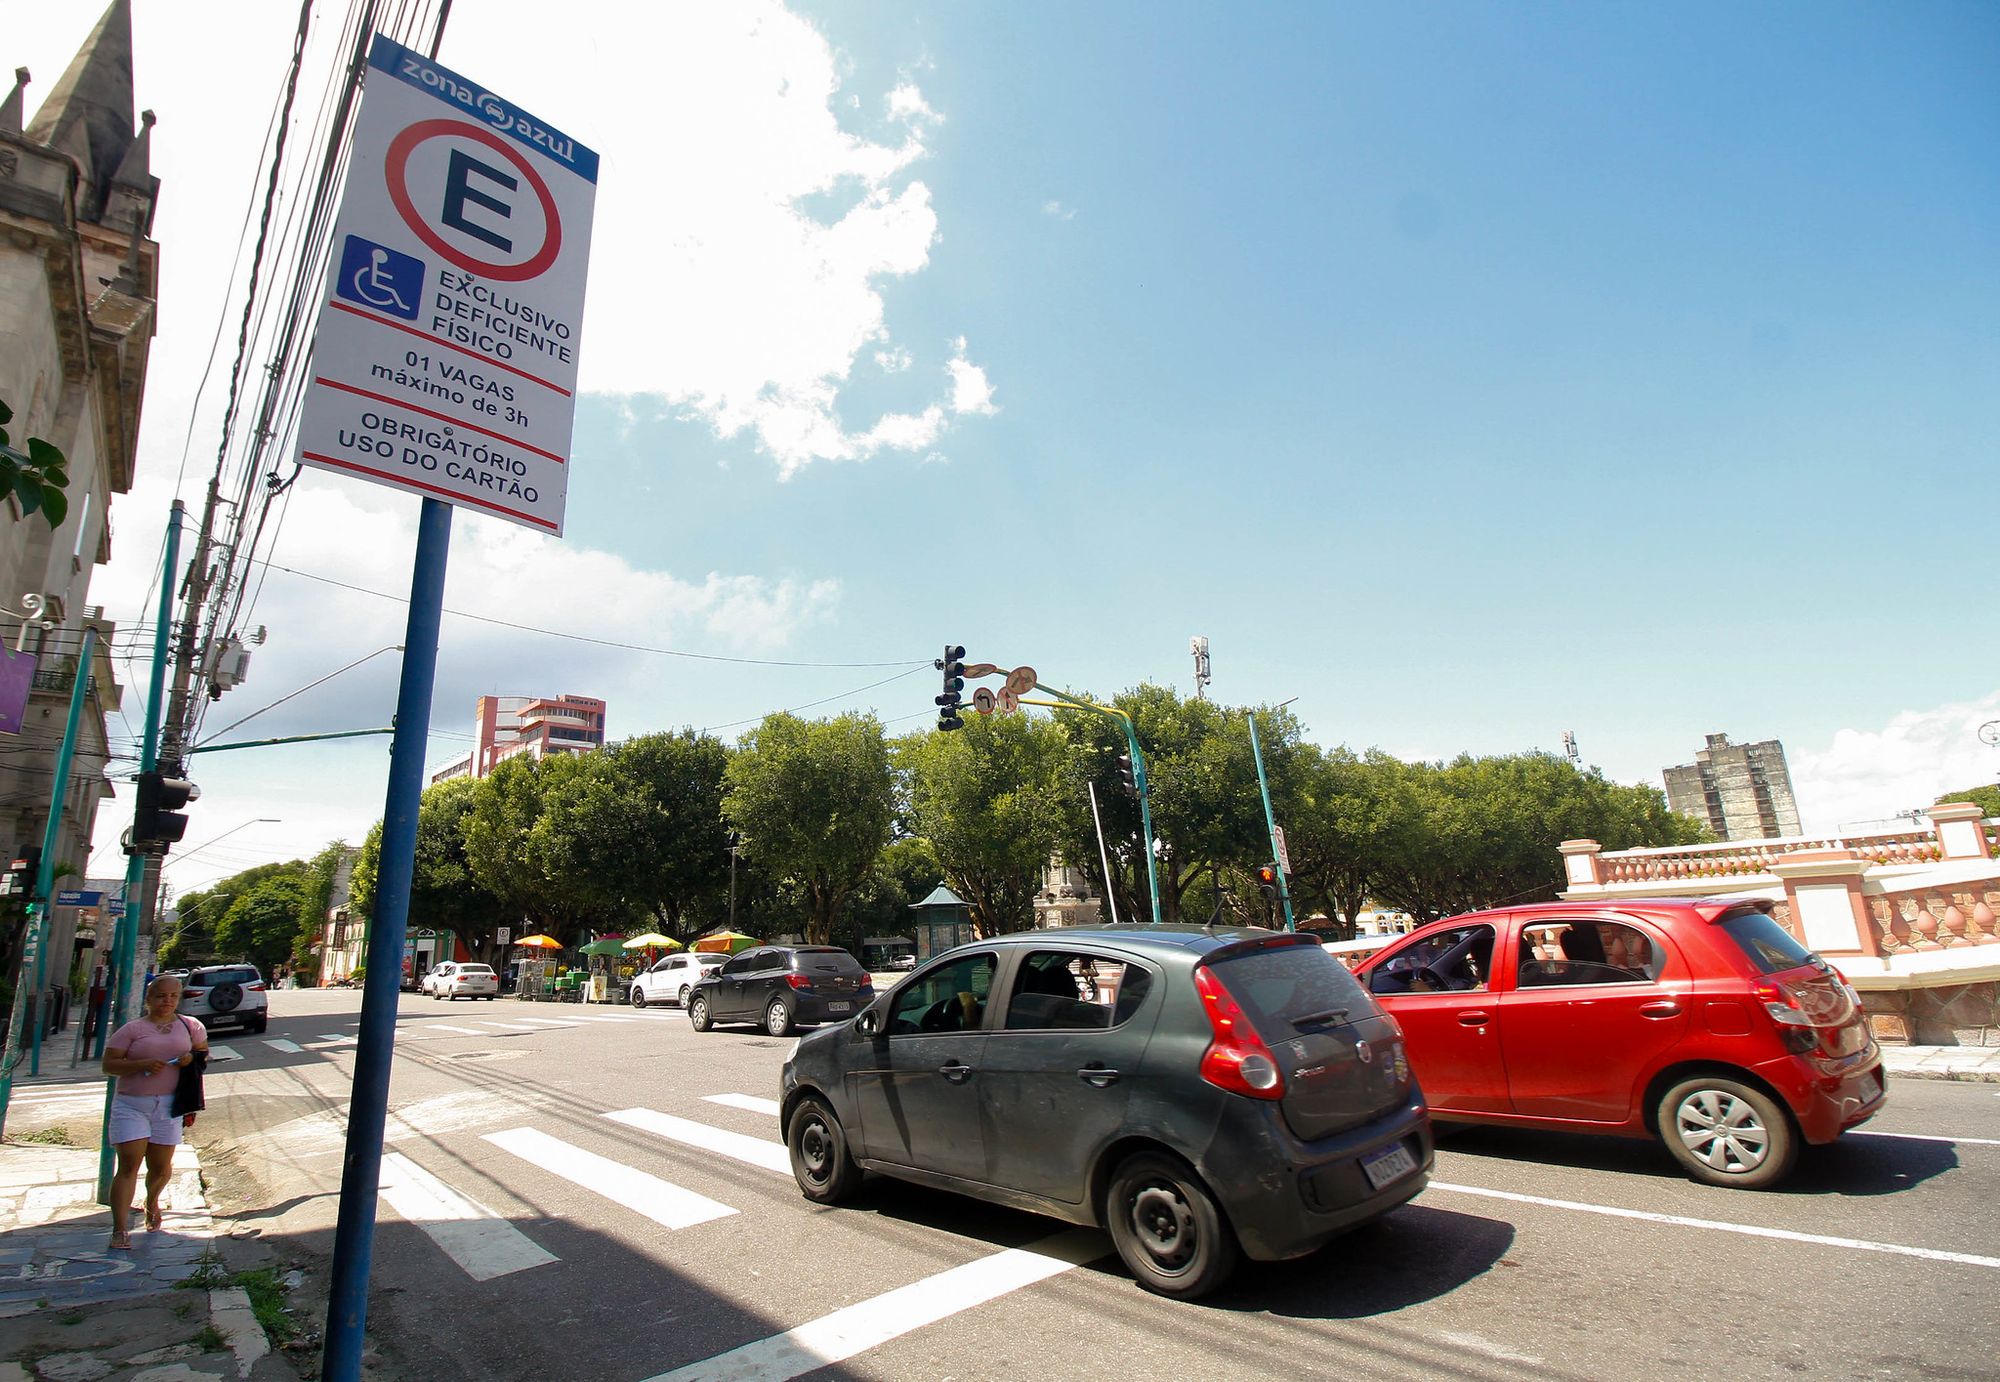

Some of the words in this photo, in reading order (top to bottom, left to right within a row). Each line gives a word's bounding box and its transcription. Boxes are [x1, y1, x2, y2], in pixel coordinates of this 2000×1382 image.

[403, 58, 473, 108] zona
[516, 122, 575, 163] azul
[442, 148, 518, 254] E
[432, 315, 513, 360] FÍSICO
[436, 293, 571, 364] DEFICIENTE
[440, 270, 570, 340] EXCLUSIVO
[371, 363, 464, 405] máximo
[472, 398, 498, 416] de
[505, 407, 529, 427] 3h
[405, 351, 430, 371] 01
[438, 361, 515, 401] VAGAS
[338, 430, 393, 458] USO
[402, 449, 438, 471] DO
[445, 462, 539, 503] CARTÃO
[361, 412, 527, 477] OBRIGATÓRIO
